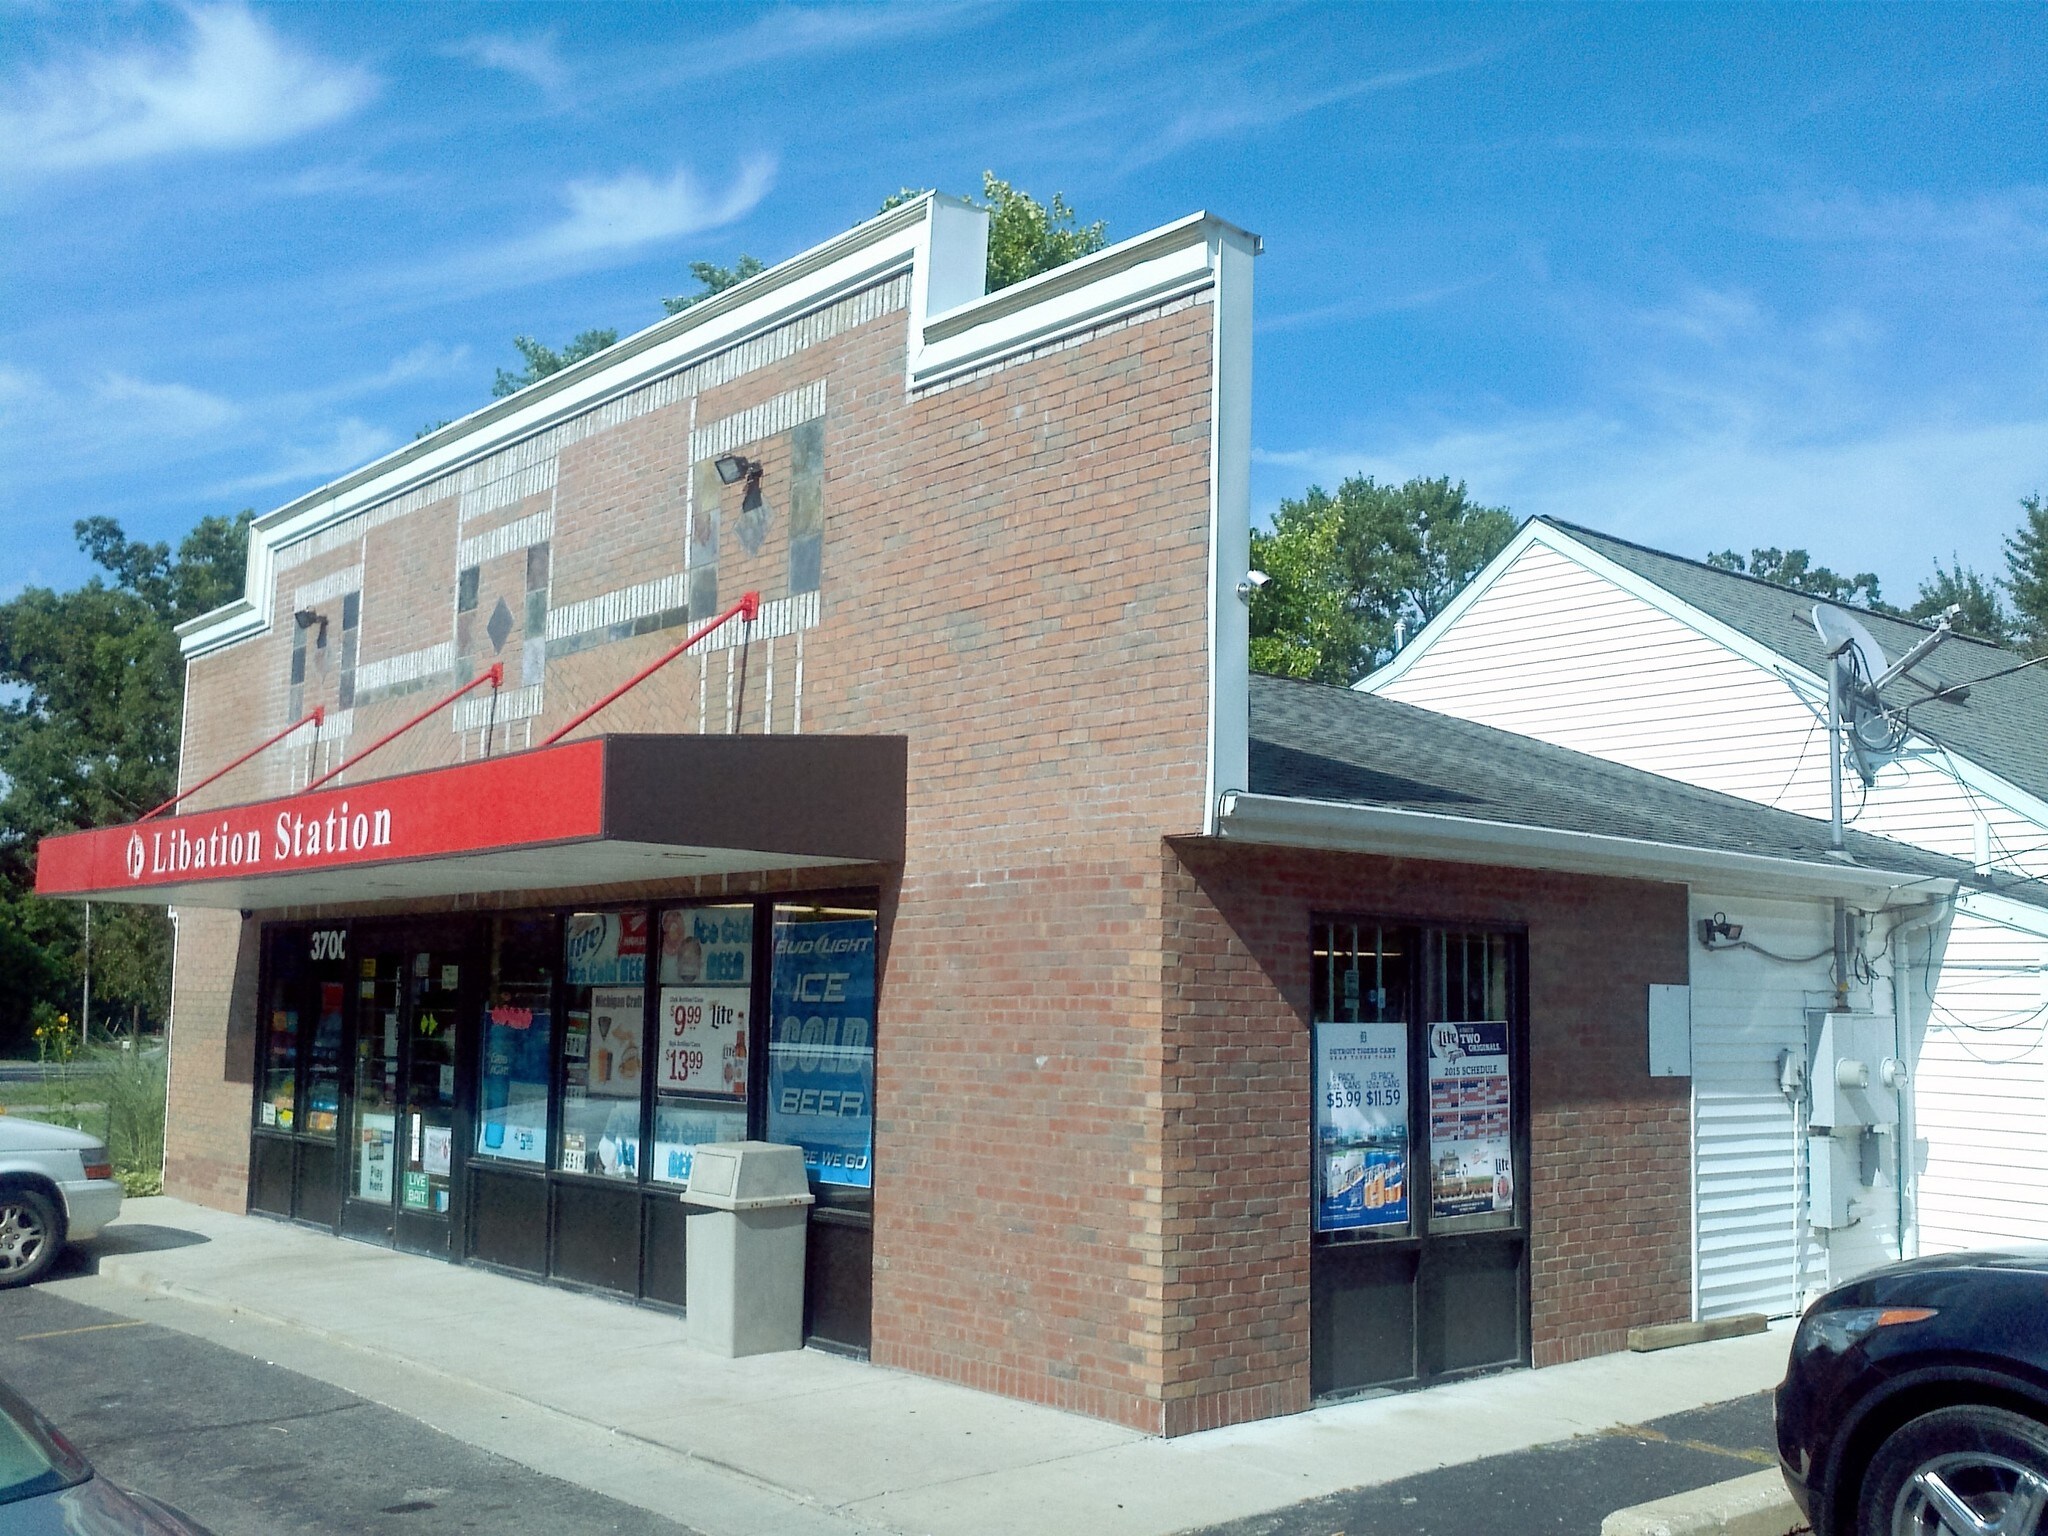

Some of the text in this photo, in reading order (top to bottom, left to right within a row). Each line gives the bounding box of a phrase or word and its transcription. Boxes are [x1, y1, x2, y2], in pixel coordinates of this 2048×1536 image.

[152, 801, 392, 874] Libation Station
[775, 937, 873, 954] BUD LIGHT
[792, 972, 850, 1002] ICE
[710, 1003, 734, 1030] Lite
[777, 1015, 869, 1073] COLD
[1459, 1033, 1481, 1044] TWO
[1444, 1064, 1498, 1077] 2015 SCHEDULE
[779, 1087, 865, 1118] BEER
[1326, 1090, 1361, 1109] $5.99
[1366, 1088, 1401, 1107] $11.59
[803, 1150, 868, 1170] RE WE GO
[409, 1173, 426, 1187] LIVE
[408, 1189, 426, 1203] BAIT
